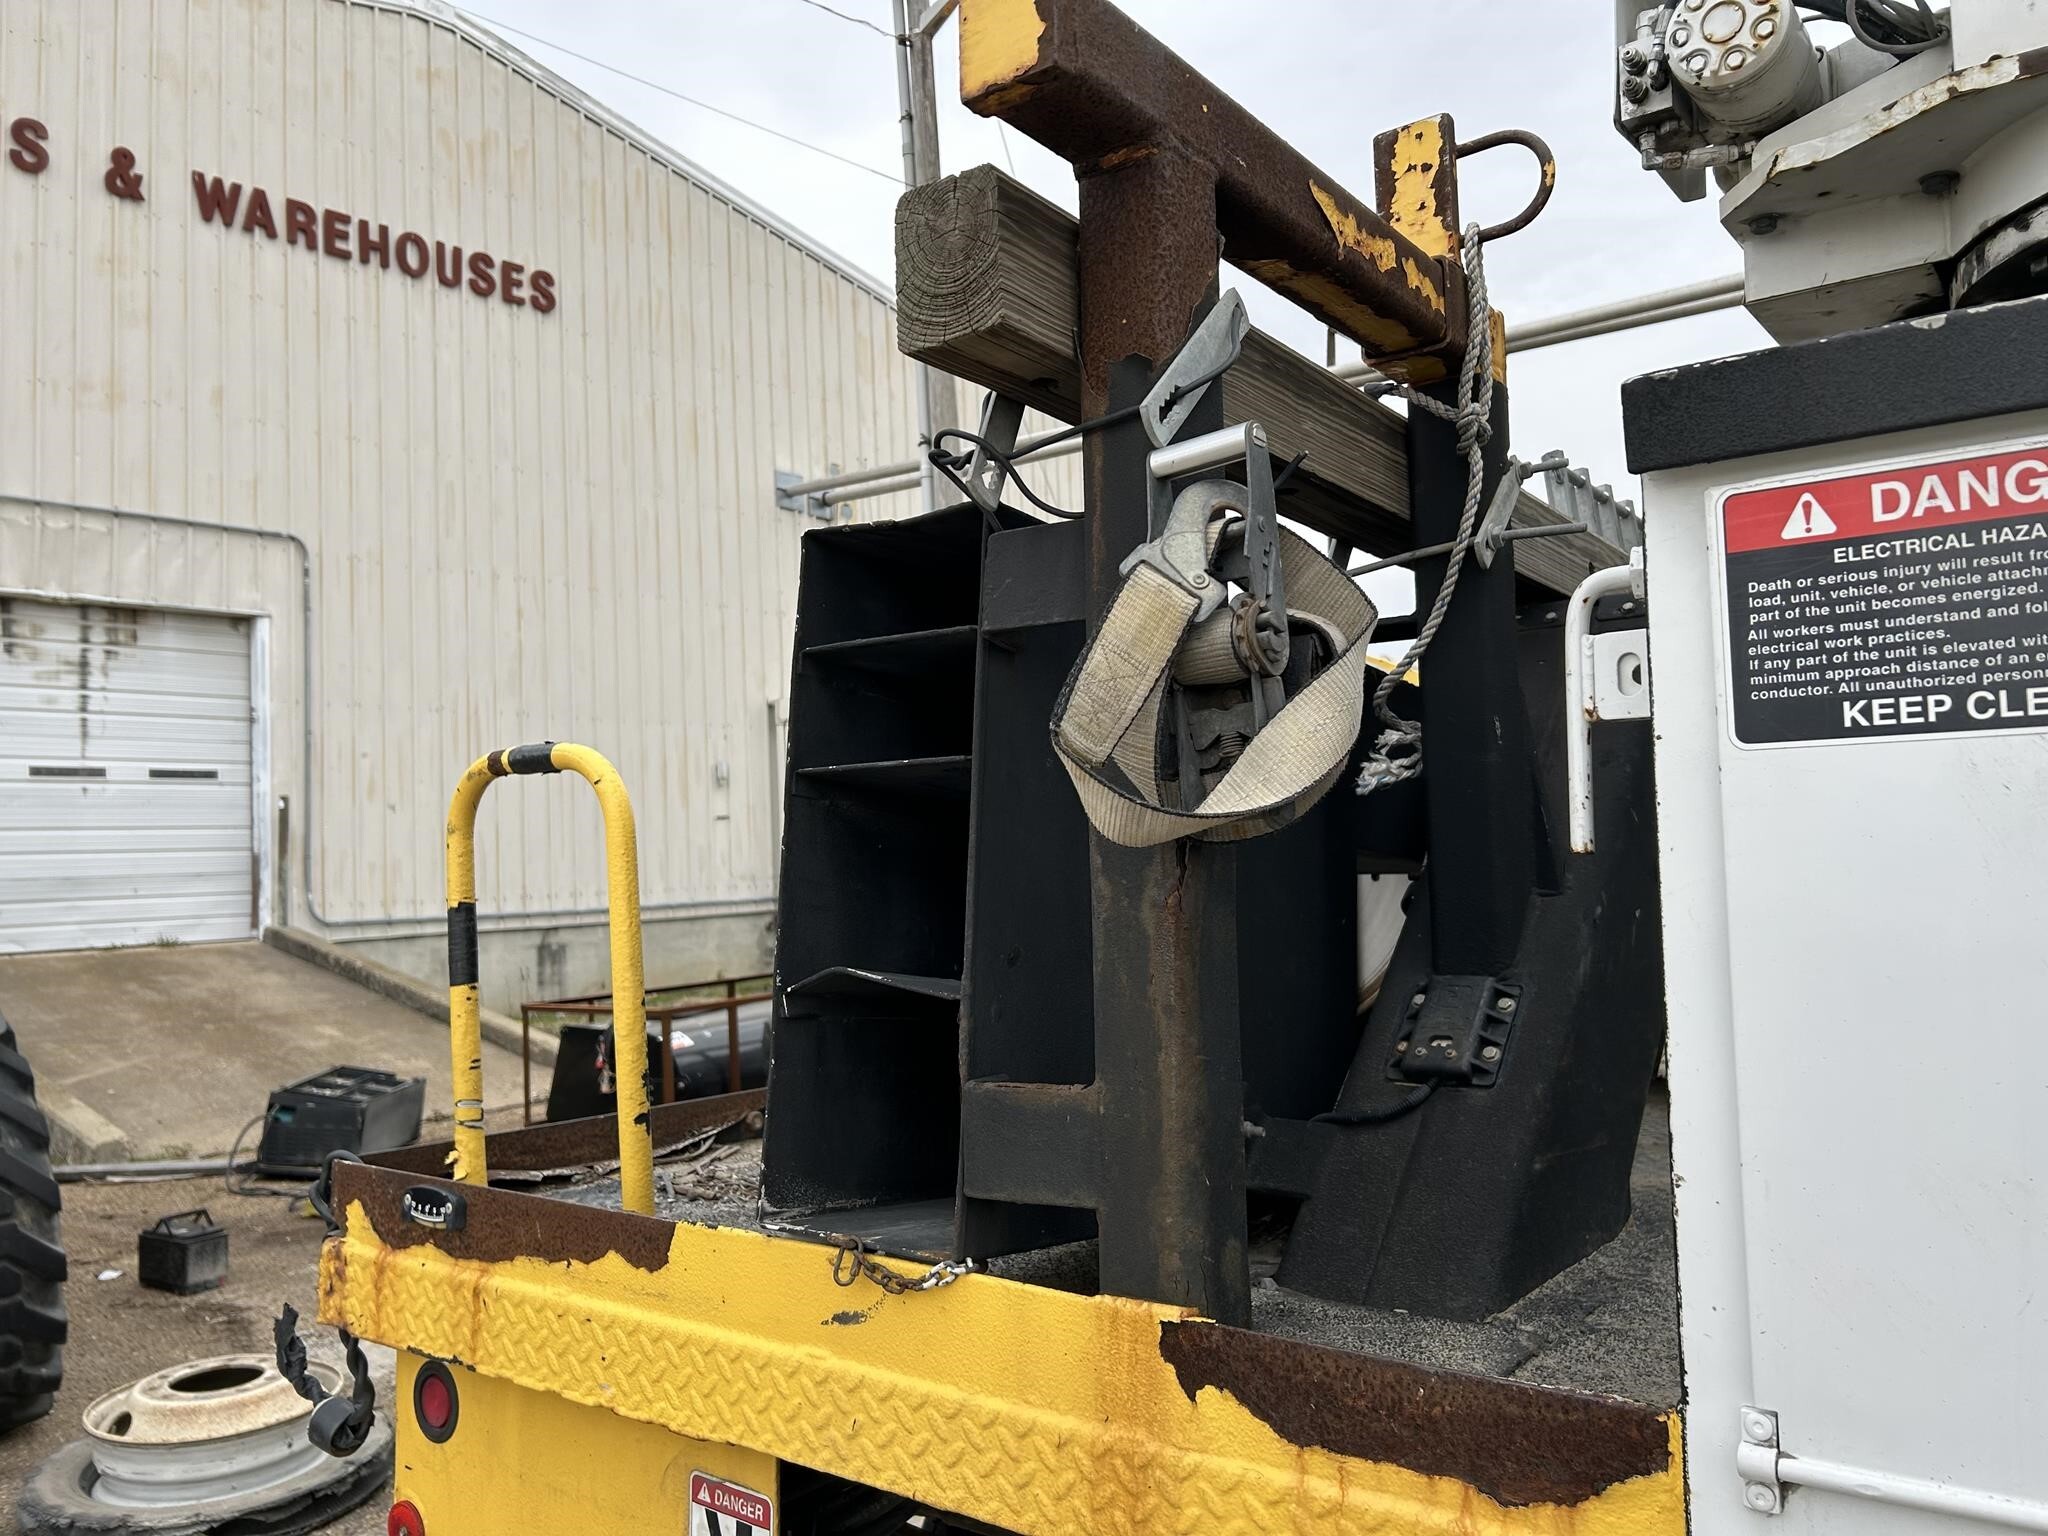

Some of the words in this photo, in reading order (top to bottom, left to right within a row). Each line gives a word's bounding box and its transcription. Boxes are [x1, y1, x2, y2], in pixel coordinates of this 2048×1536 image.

[10, 117, 49, 174] S
[104, 146, 146, 202] &
[191, 169, 557, 314] WAREHOUSES
[1871, 459, 2048, 523] DANG
[1833, 532, 1975, 563] ELECTRICAL
[1981, 522, 2048, 545] HAZA
[1748, 578, 1791, 593] Death
[1796, 577, 1813, 588] or
[1818, 570, 1878, 585] serious
[1883, 563, 1931, 578] injury
[1937, 557, 1966, 571] will
[1973, 551, 2024, 567] result
[1749, 594, 1786, 608] load,
[1898, 581, 1915, 592] or
[1921, 572, 1982, 589] vehicle
[1750, 609, 1780, 625] part
[1785, 607, 1800, 619] of
[1805, 605, 1830, 617] the
[1835, 600, 1866, 614] unit
[1872, 594, 1947, 610] becomes
[1952, 582, 2044, 601] energized.
[1748, 629, 1767, 641] All
[1773, 624, 1834, 639] workers
[1840, 618, 1879, 632] must
[1885, 607, 1981, 628] understand
[1987, 604, 2019, 618] and
[1749, 639, 1819, 656] electrical
[1824, 635, 1863, 649] work
[1868, 628, 1950, 647] practices.
[1749, 659, 1759, 670] If
[1764, 658, 1791, 671] any
[1796, 654, 1828, 669] part
[1832, 651, 1848, 663] of
[1853, 649, 1880, 661] the
[1885, 645, 1917, 659] unit
[1922, 644, 1938, 656] is
[1943, 636, 2016, 653] elevated
[1750, 671, 1820, 685] minimum
[1825, 663, 1901, 680] approach
[1906, 658, 1979, 673] distance
[1985, 654, 2002, 666] of
[2008, 652, 2029, 665] an
[1751, 685, 1833, 700] conductor.
[1838, 681, 1860, 694] All
[1865, 672, 1977, 692] unauthorized
[1842, 694, 1953, 728] KEEP
[1966, 686, 2048, 720] CLE
[714, 1489, 764, 1521] DANGER
